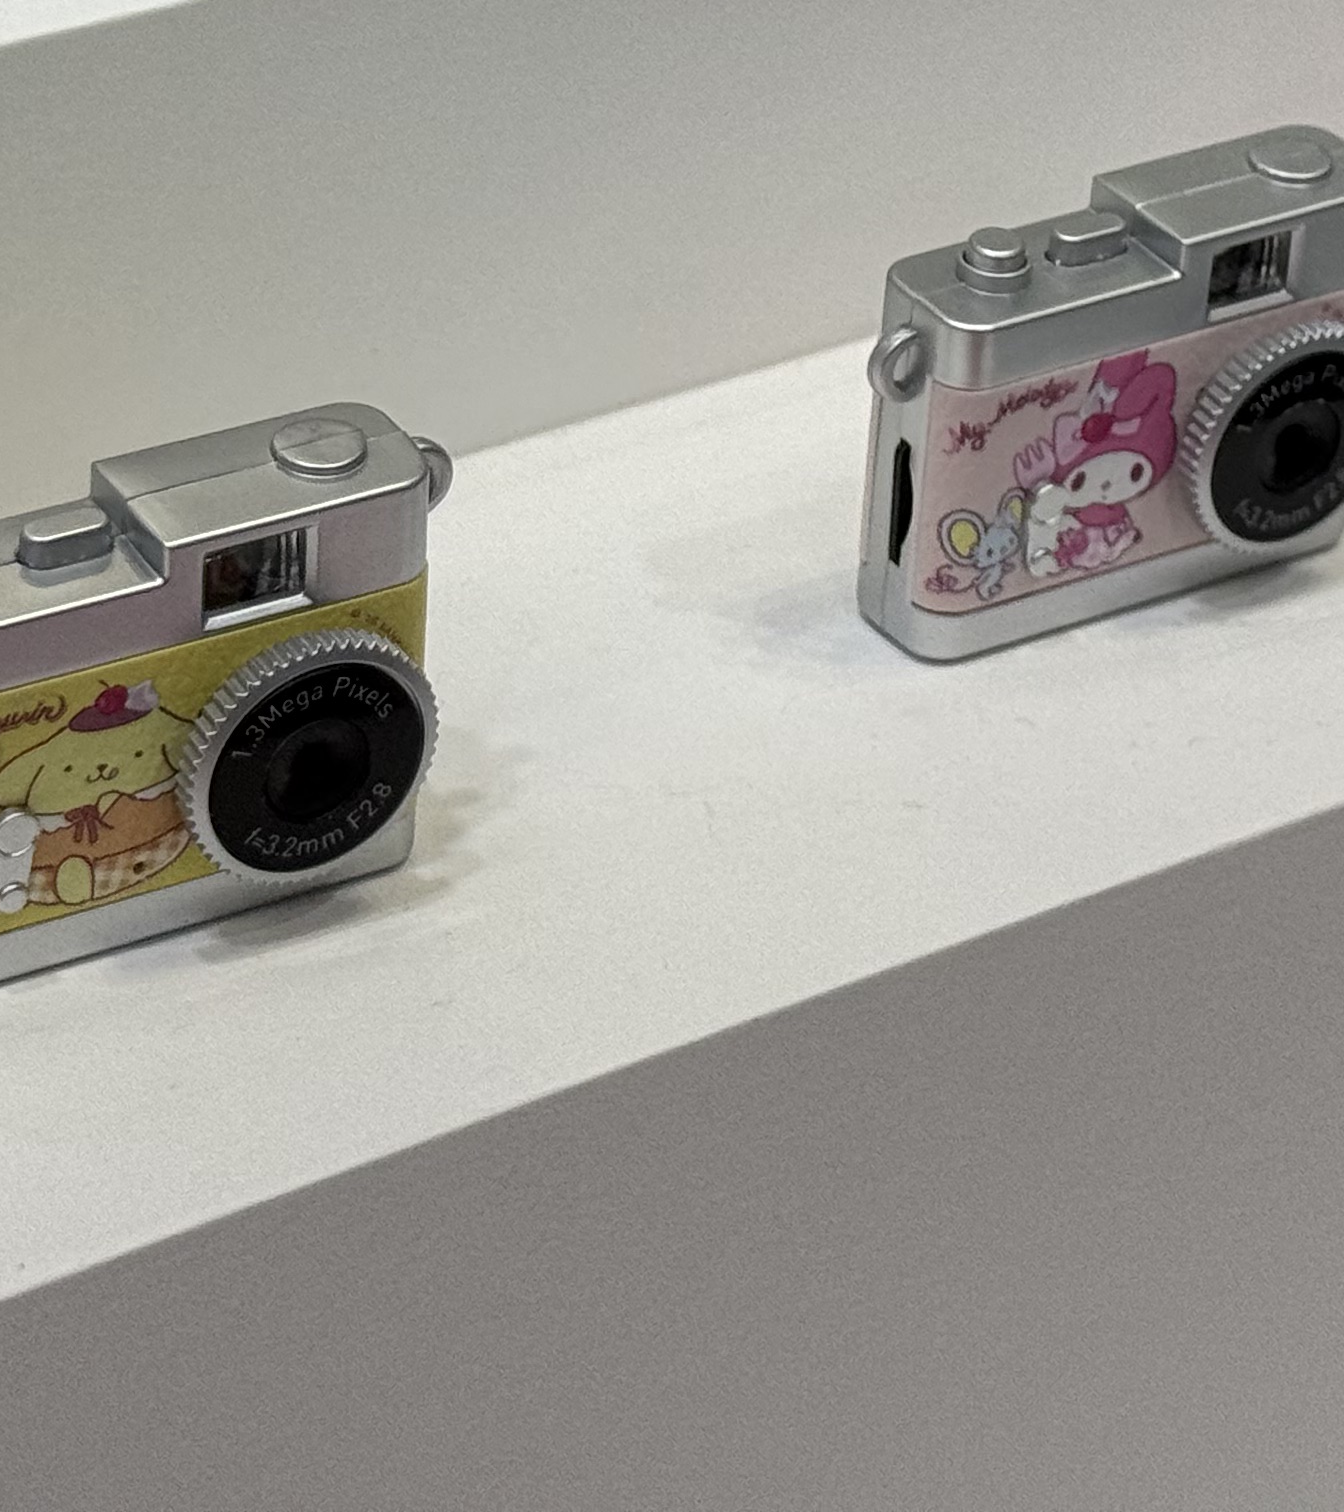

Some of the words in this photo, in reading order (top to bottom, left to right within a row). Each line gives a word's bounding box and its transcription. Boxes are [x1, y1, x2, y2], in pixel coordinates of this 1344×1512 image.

[231, 685, 324, 759] 1.3Mega
[331, 675, 395, 719] Pixels
[346, 781, 393, 830] F2.8
